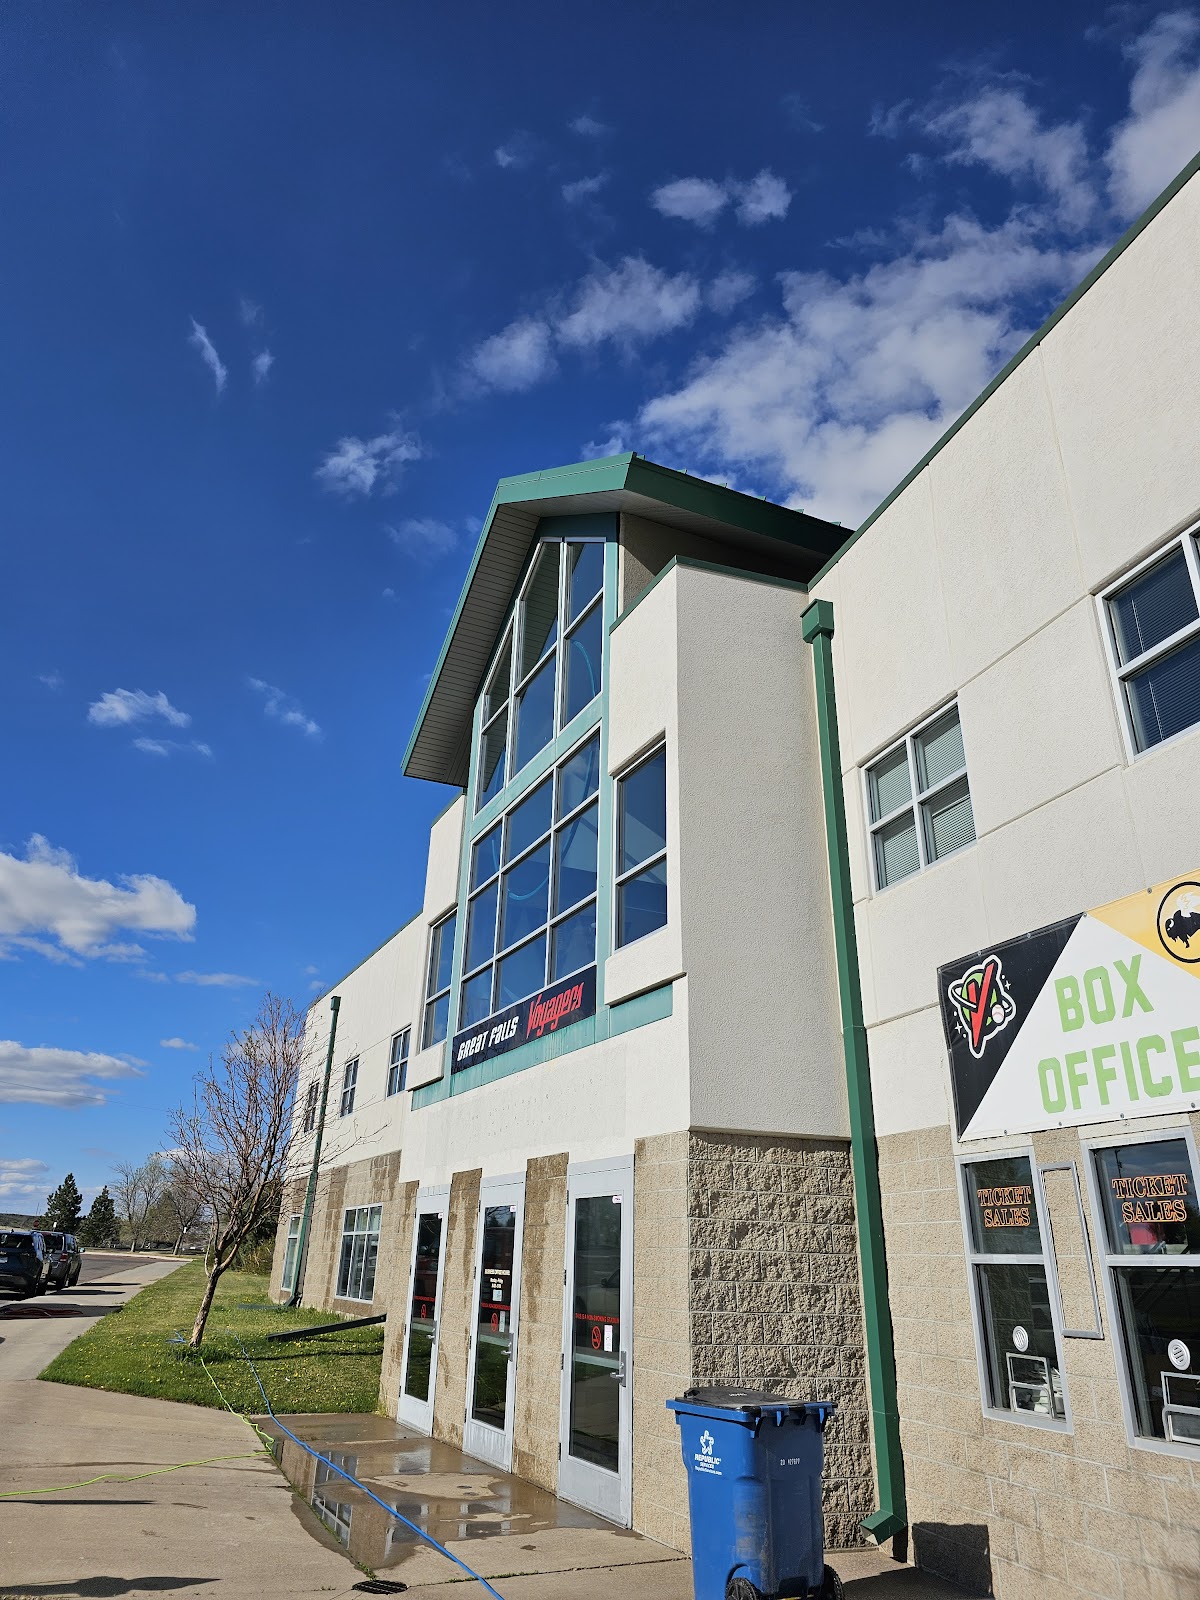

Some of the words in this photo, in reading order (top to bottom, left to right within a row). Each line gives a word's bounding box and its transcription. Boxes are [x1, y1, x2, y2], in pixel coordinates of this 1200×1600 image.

[1054, 954, 1154, 1033] BOX
[526, 981, 585, 1040] Voyagers
[1037, 1026, 1200, 1114] OFFICE
[977, 1186, 1031, 1206] TICKET
[1112, 1174, 1188, 1198] TICKET
[984, 1208, 1031, 1227] SALES
[1122, 1200, 1187, 1222] SALES
[695, 1453, 720, 1465] REPUBLIC
